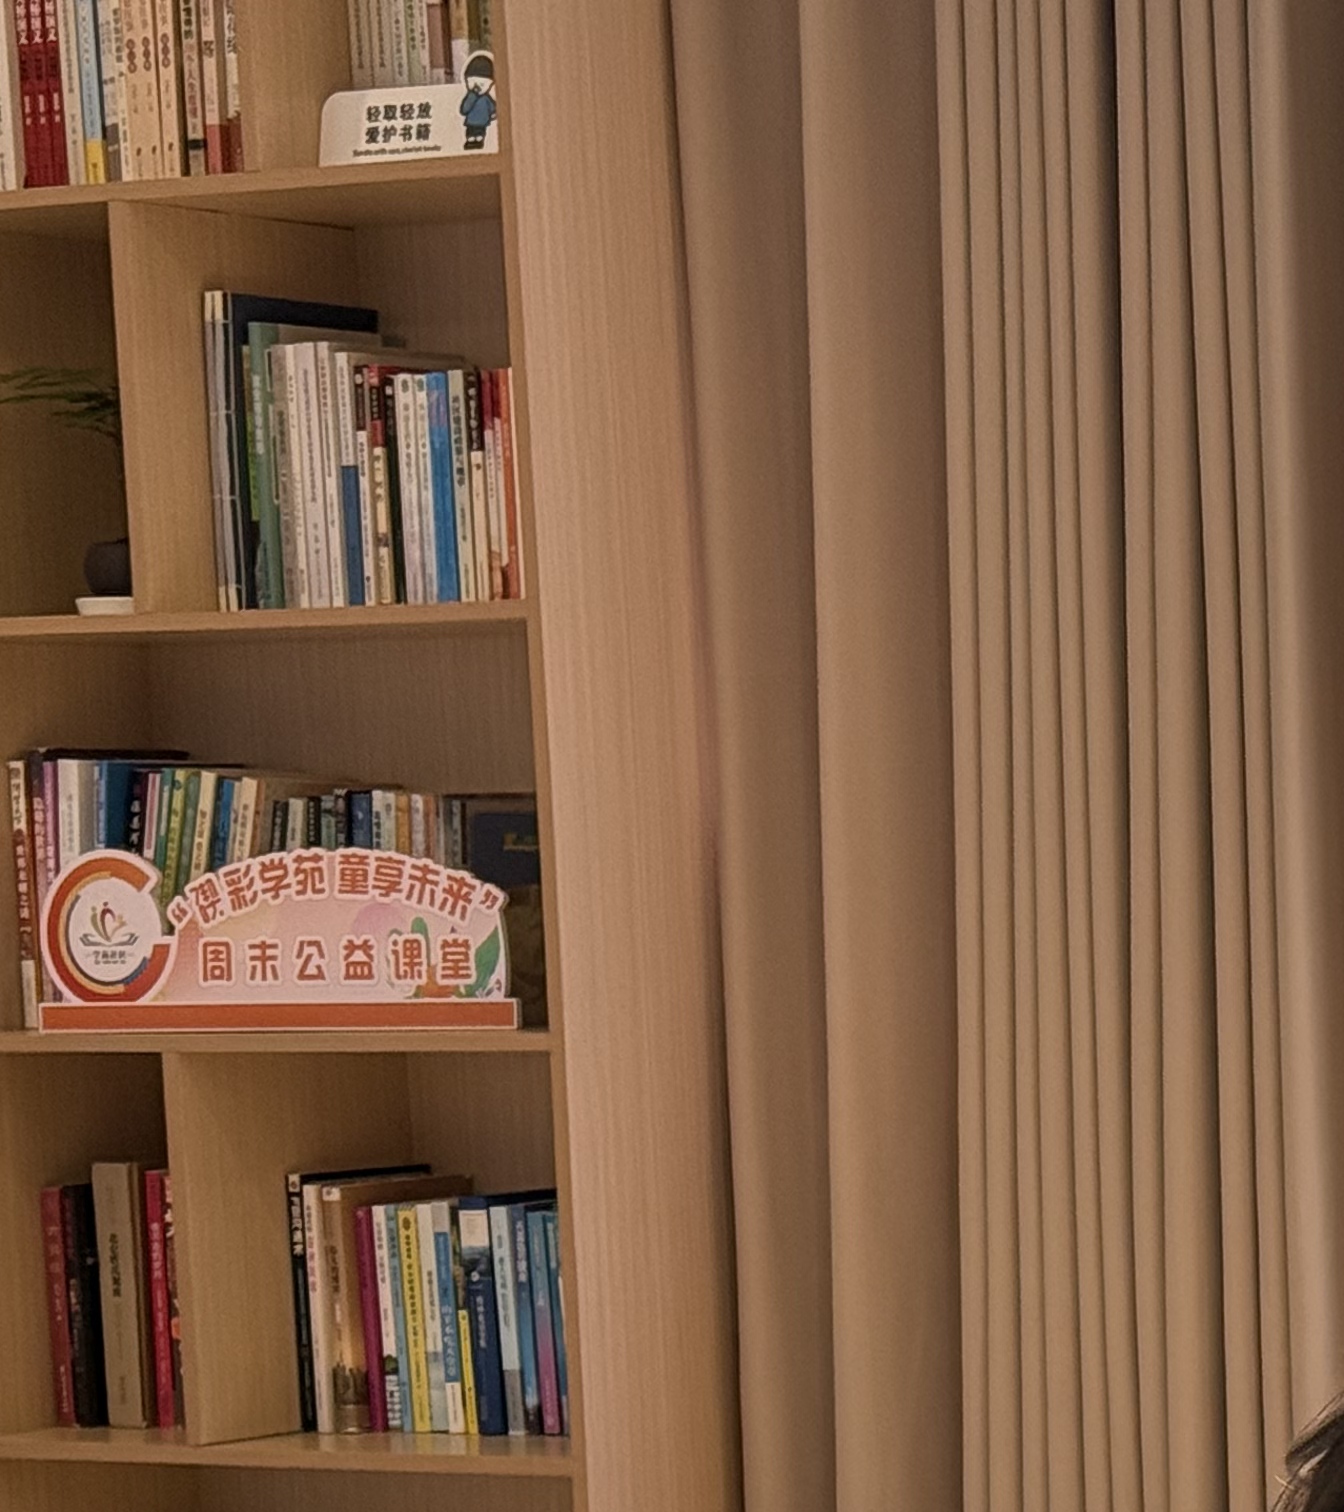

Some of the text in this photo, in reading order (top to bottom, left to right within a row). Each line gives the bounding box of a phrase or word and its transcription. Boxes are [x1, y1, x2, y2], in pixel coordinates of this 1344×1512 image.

[366, 102, 432, 123] 轻取轻放
[365, 123, 431, 144] 爱护书籍
[202, 938, 471, 982] 周末公益课堂
